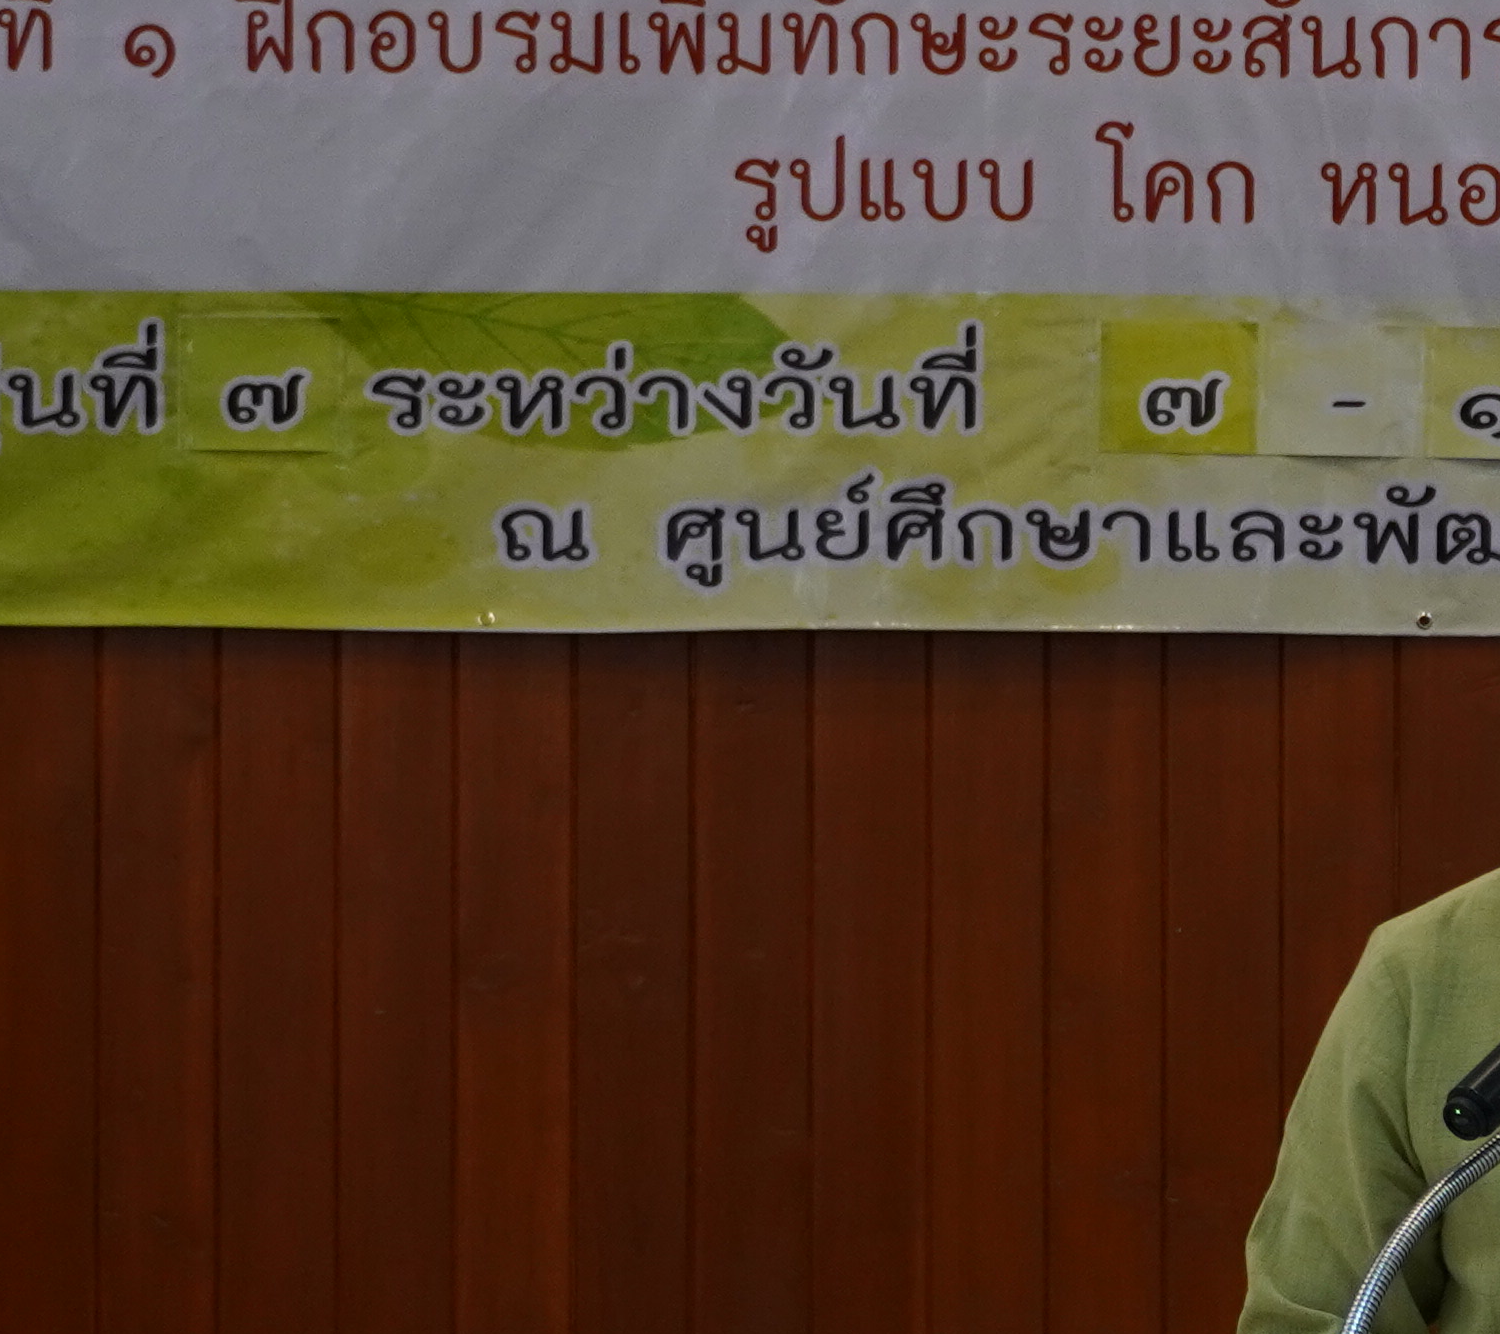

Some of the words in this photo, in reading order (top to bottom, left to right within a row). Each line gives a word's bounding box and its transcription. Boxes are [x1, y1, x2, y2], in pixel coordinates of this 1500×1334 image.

[122, 22, 177, 78] ๑
[734, 133, 1035, 255] รูปแบบ
[1095, 121, 1256, 225] โคก
[226, 373, 304, 425] ๗
[371, 324, 978, 431] ระหว่างวันที่
[1145, 377, 1222, 428] ๗
[500, 508, 590, 563] ณ
